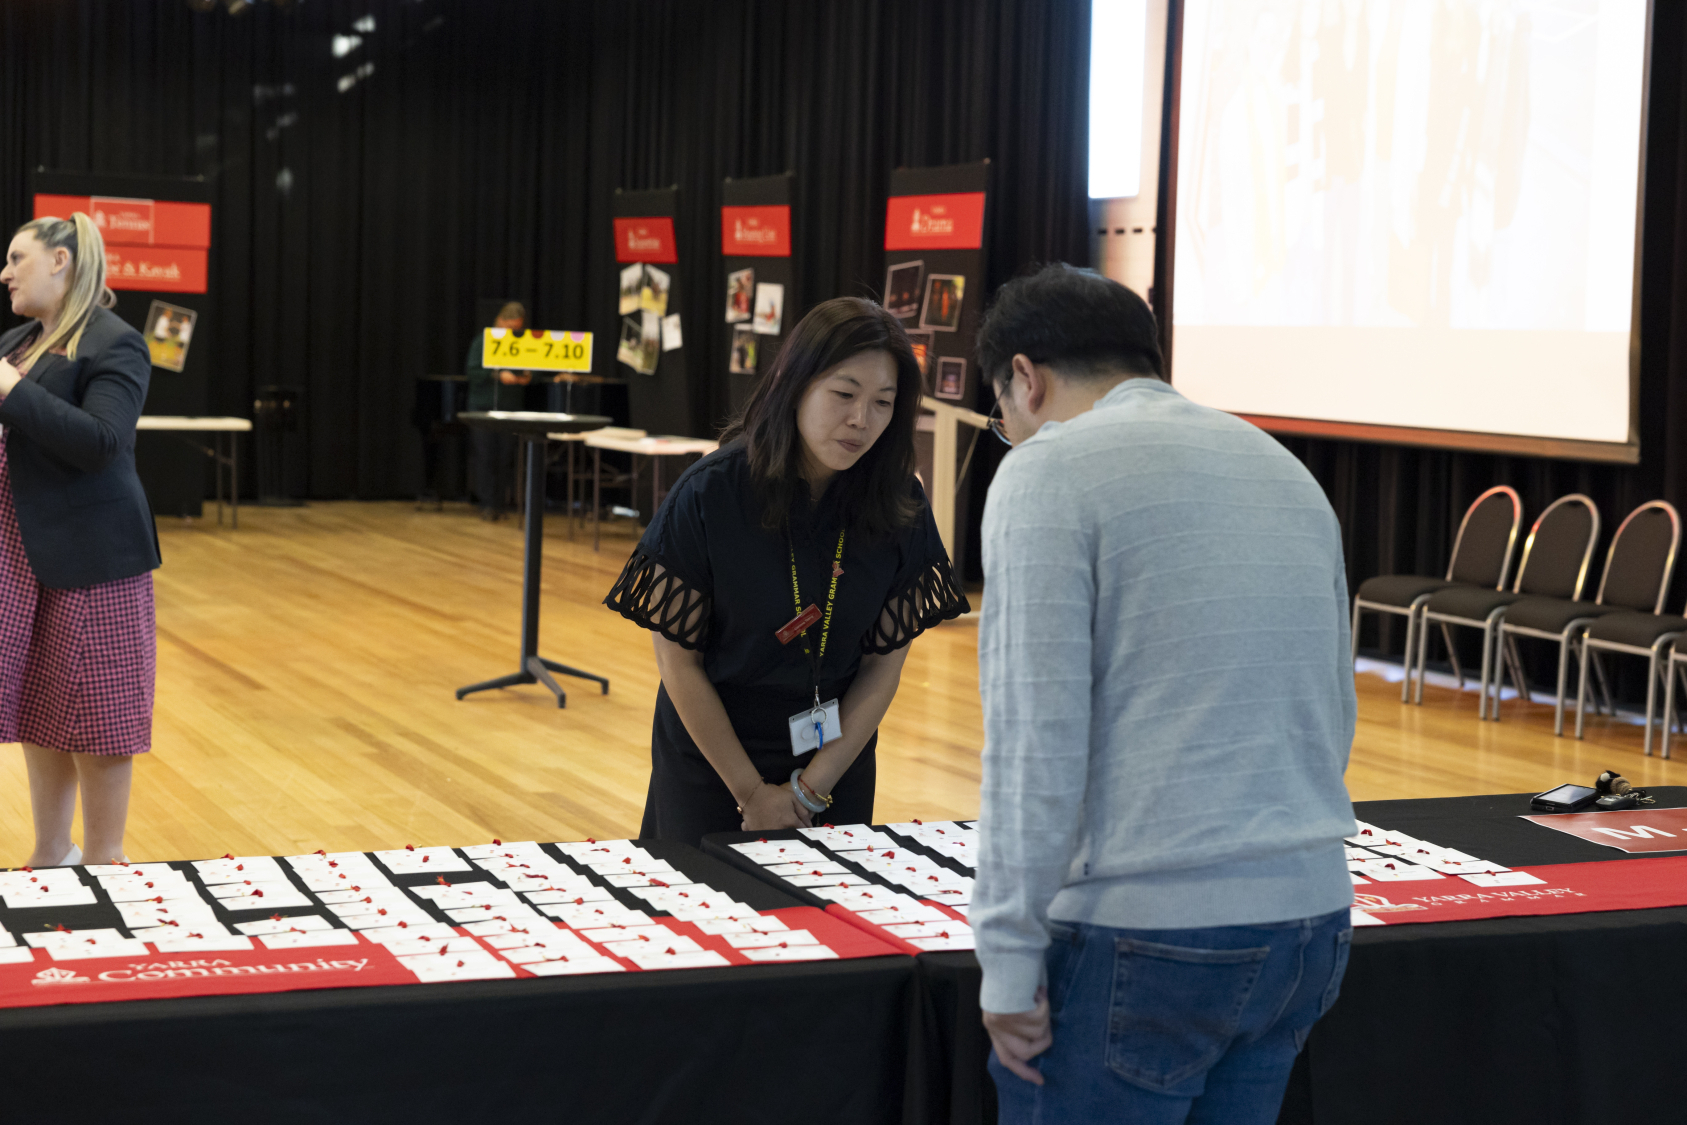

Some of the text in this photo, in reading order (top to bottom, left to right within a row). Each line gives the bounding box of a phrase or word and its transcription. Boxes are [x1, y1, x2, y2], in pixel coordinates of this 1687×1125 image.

[491, 340, 520, 357] 7.6
[544, 342, 584, 360] 7.10
[791, 564, 801, 605] GRAMMAR
[819, 528, 845, 657] YARRA VALLEY GRAMR SCHOOL
[1591, 825, 1677, 840] M
[1411, 887, 1576, 903] YARRA VALLEY
[1431, 892, 1587, 906] GRAMMAR
[99, 958, 368, 982] Community
[128, 959, 231, 971] YARRA
